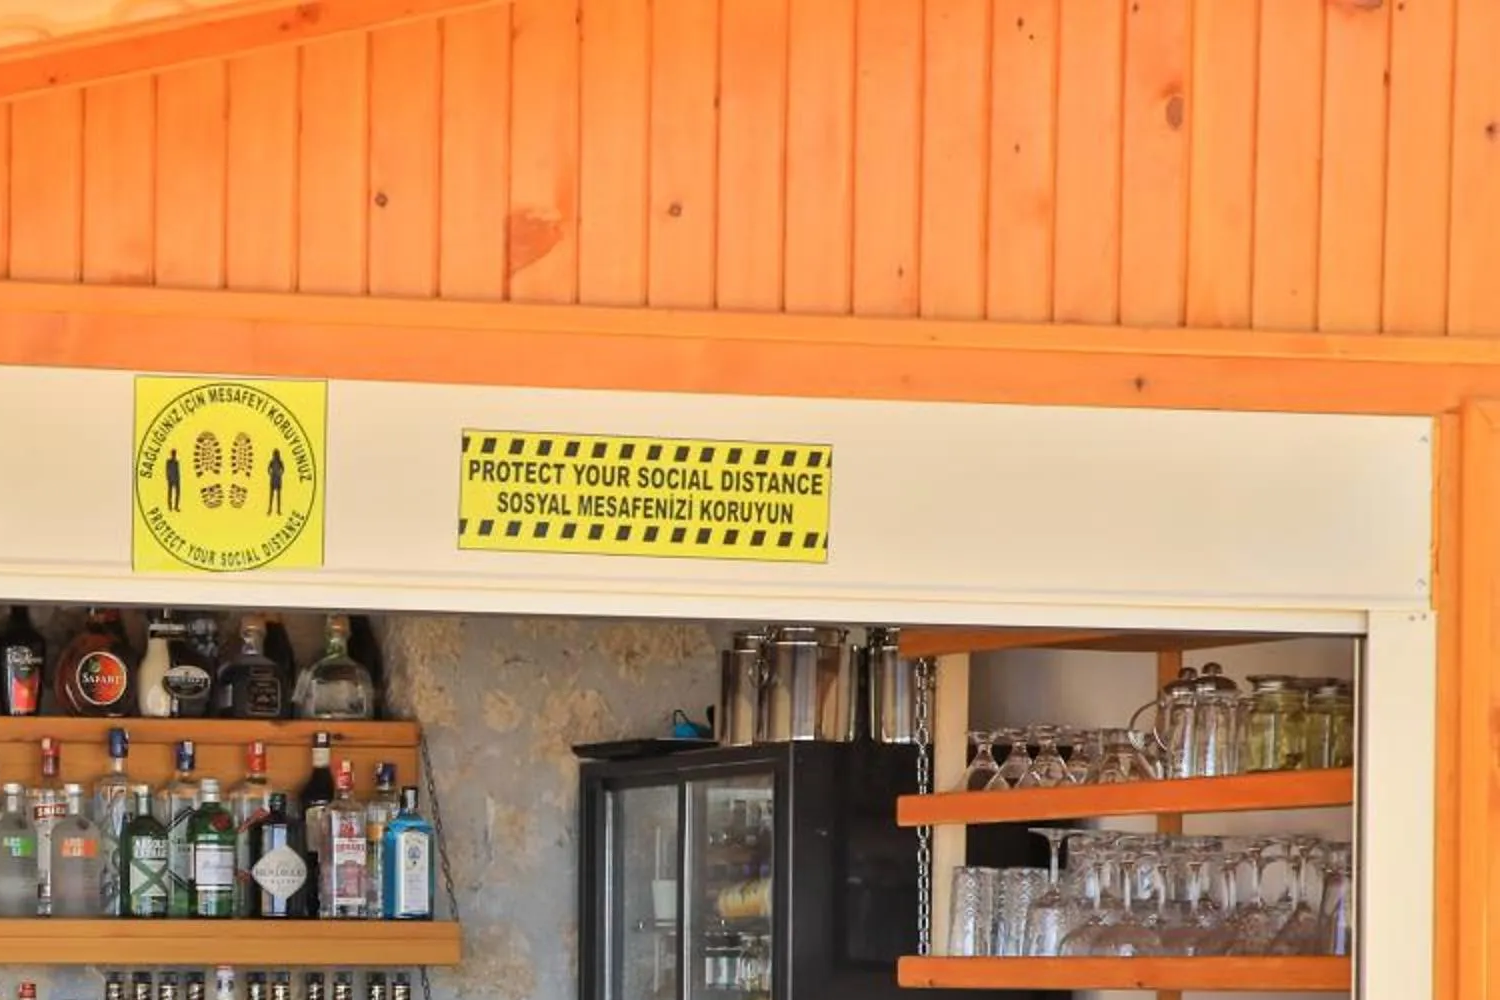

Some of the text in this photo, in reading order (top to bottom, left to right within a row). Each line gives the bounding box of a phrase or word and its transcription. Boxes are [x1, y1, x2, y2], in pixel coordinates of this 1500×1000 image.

[267, 405, 313, 484] KORUYUNUZ
[468, 459, 824, 496] PROTECT YOUR SOCIAL DISTANCE
[496, 491, 794, 525] SOSYAL MESAFENİZİ KORUYUN
[146, 506, 305, 567] PROTECT YOUR SOCIAL DISTANCE
